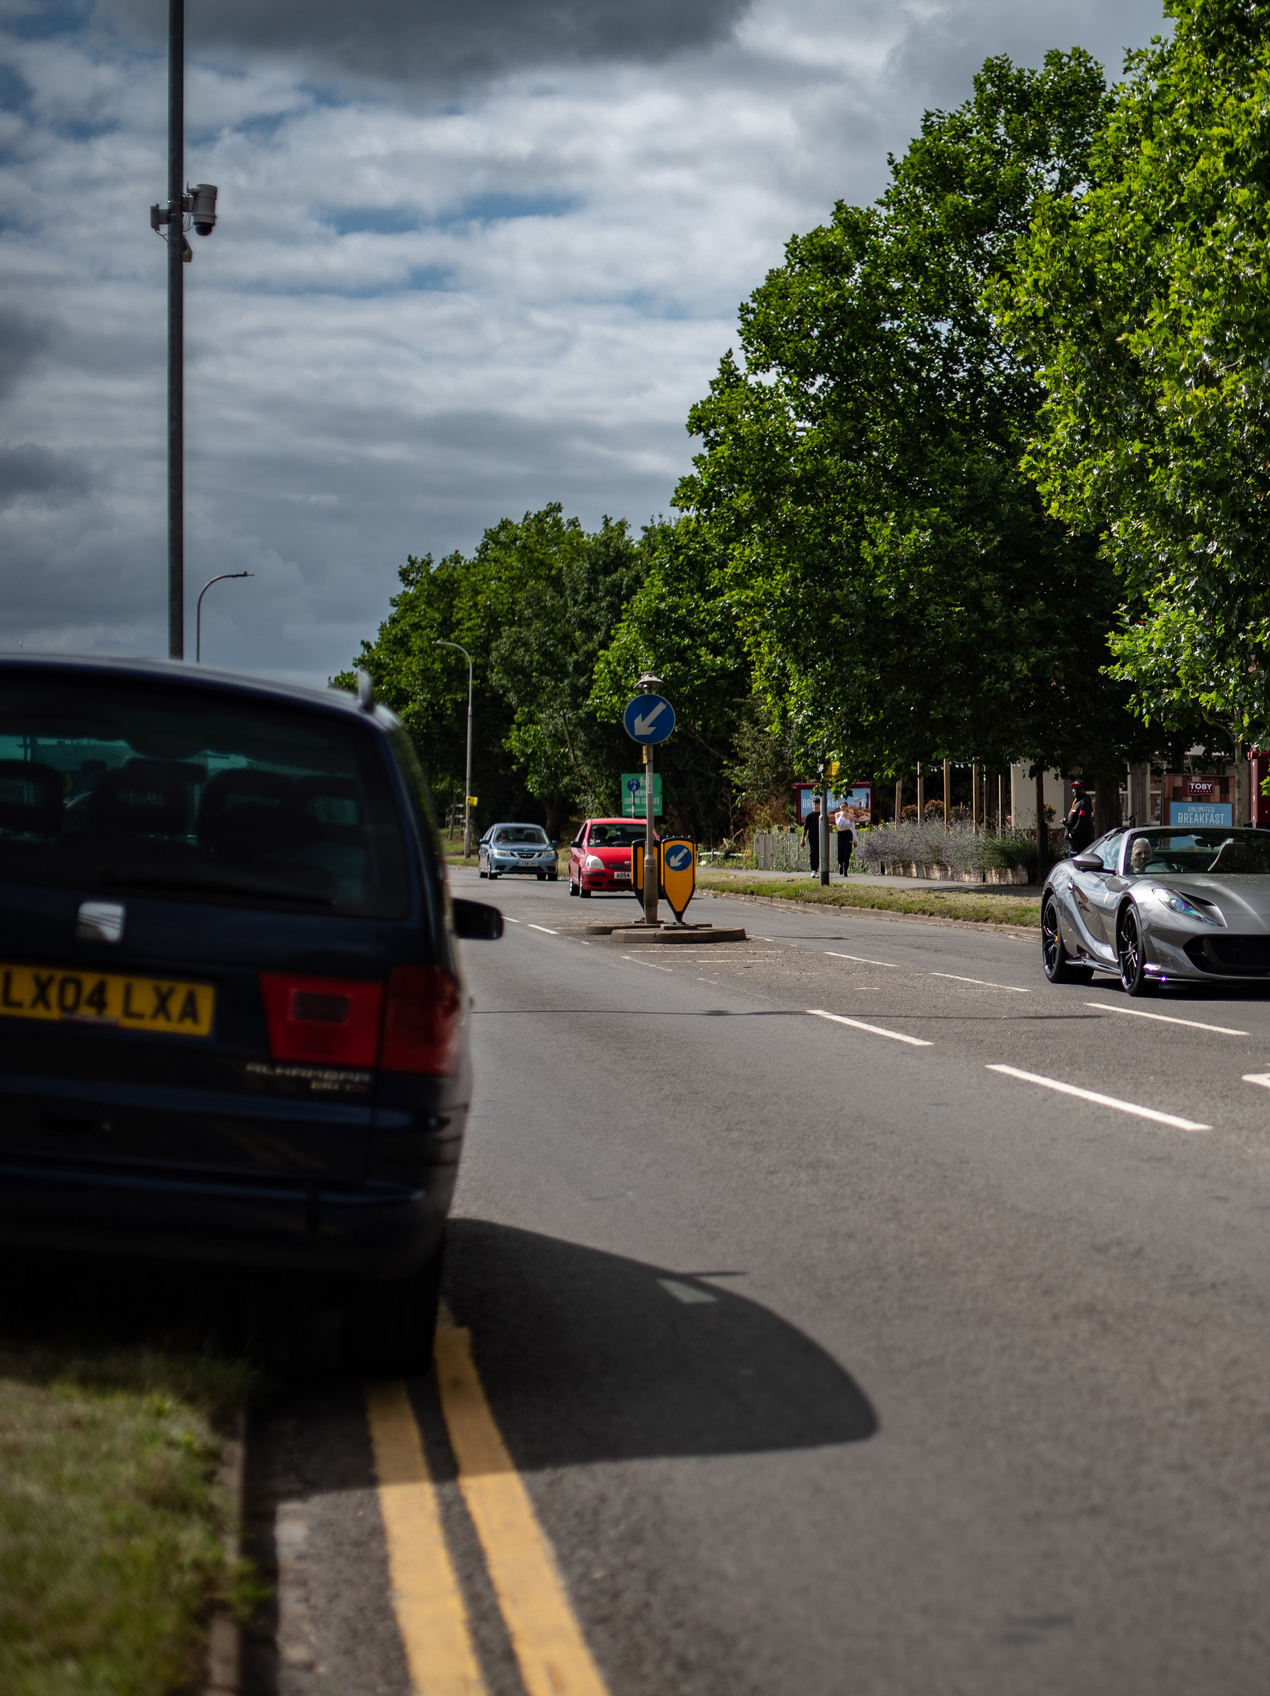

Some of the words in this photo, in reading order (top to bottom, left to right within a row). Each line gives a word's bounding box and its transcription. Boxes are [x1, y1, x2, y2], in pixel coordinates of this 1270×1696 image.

[1189, 782, 1212, 790] TOBY
[1178, 812, 1225, 824] BREAKFAST
[1, 967, 107, 1015] LX04
[123, 981, 200, 1024] LXA
